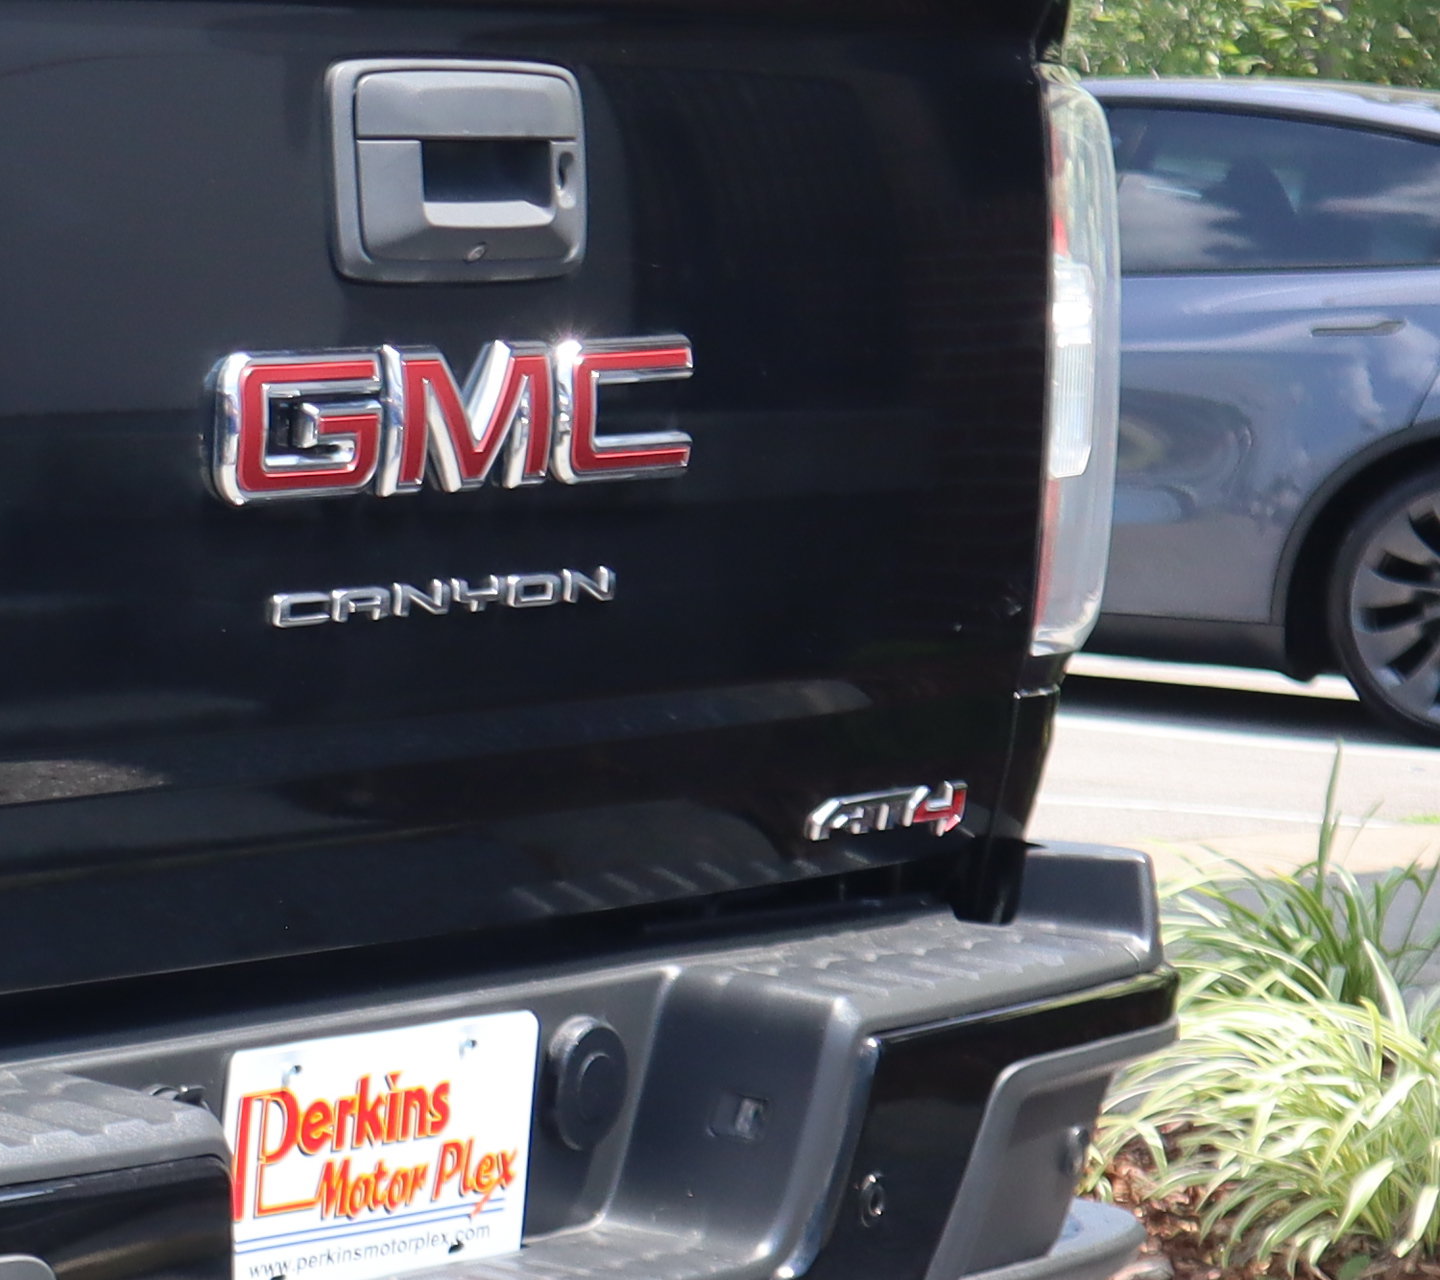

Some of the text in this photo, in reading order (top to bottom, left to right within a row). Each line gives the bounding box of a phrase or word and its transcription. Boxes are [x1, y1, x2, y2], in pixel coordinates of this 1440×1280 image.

[205, 333, 692, 504] GMC
[266, 564, 616, 628] CANYON
[804, 778, 967, 840] AT4
[232, 1070, 452, 1223] Perkins
[317, 1135, 518, 1221] Motor Plex
[248, 1223, 492, 1278] www.perkinsmotorplex.com
